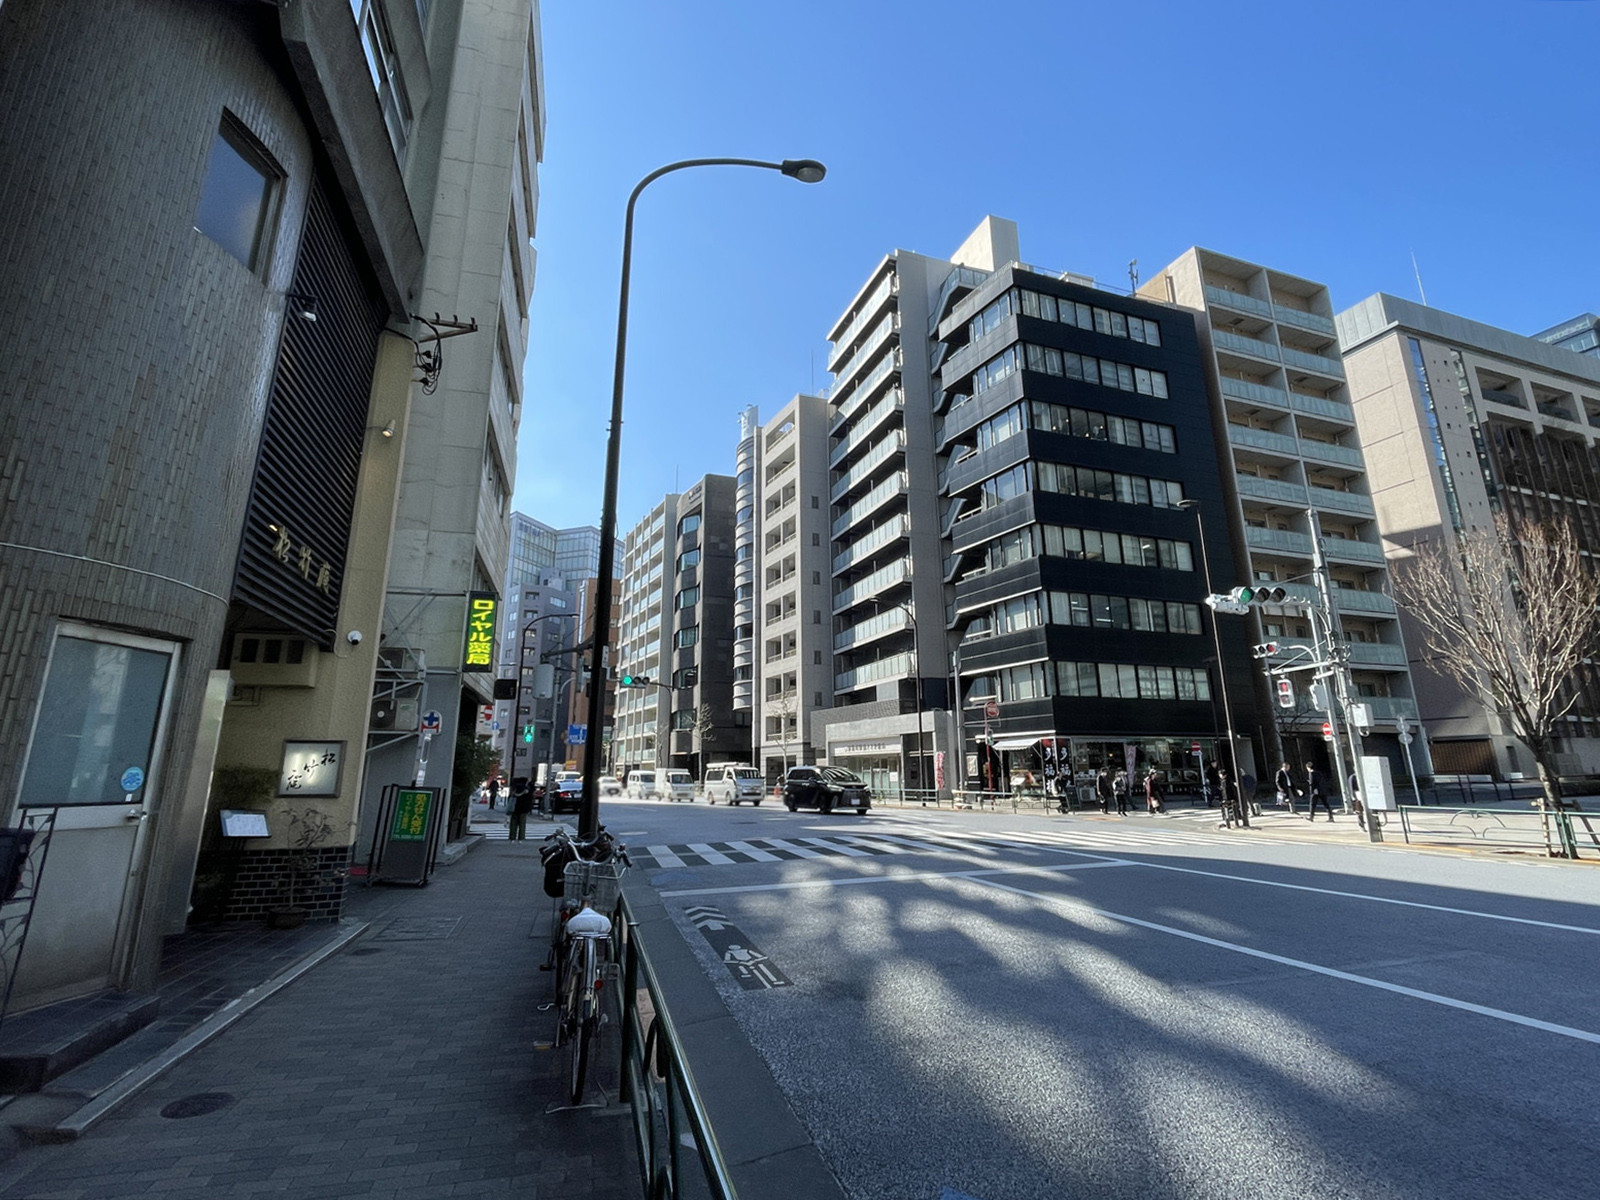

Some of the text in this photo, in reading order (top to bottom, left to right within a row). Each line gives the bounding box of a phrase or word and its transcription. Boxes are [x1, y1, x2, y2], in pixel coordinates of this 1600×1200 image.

[466, 599, 494, 665] ロイヤル薬局
[409, 793, 428, 834] 処方せん受付
